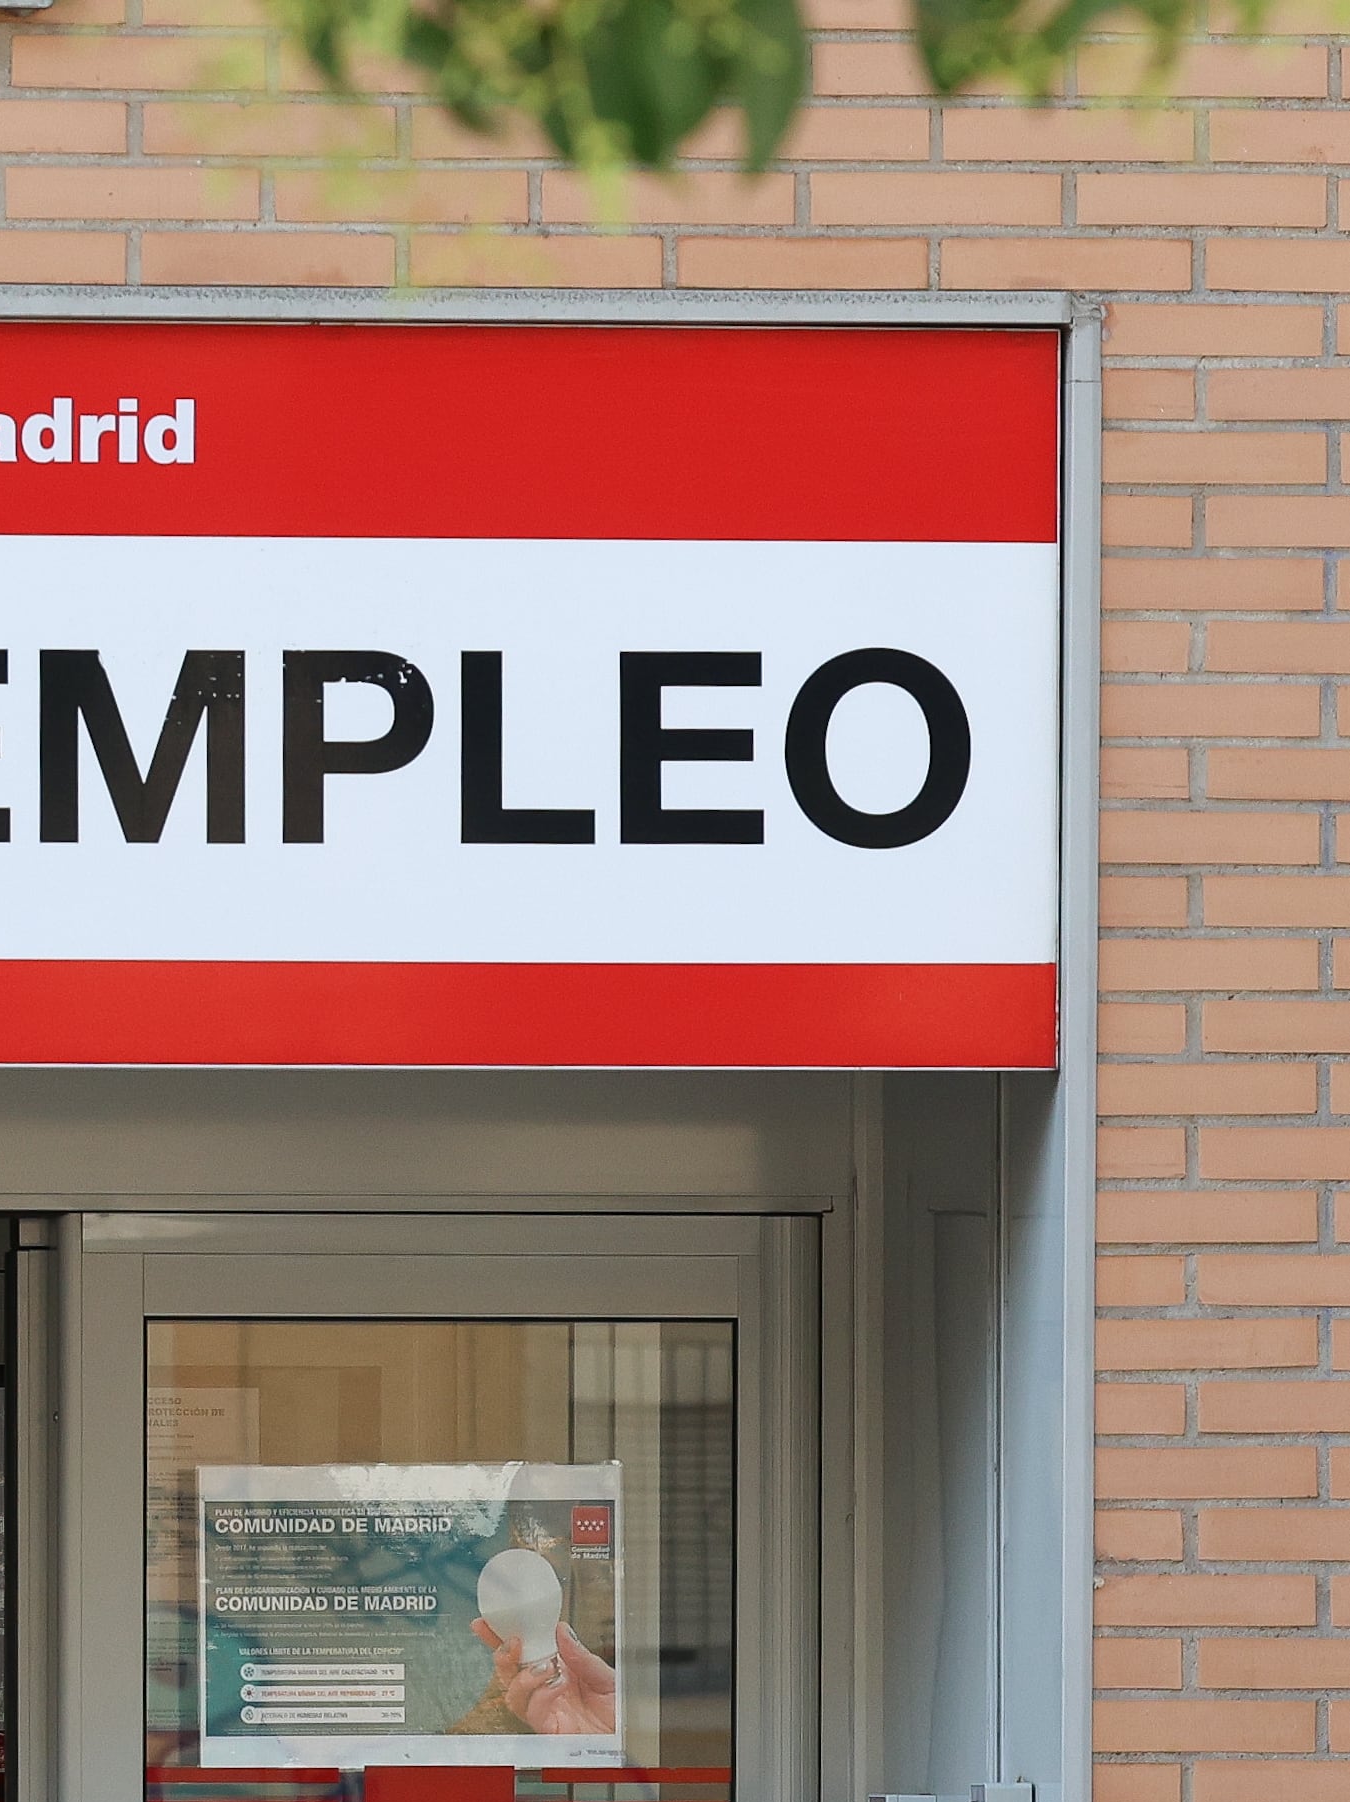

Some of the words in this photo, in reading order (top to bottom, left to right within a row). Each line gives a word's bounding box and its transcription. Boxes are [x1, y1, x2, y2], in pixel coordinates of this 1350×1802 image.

[215, 1518, 335, 1533] COMUNIDAD
[342, 1518, 368, 1532] DE
[375, 1518, 452, 1533] MADRID
[216, 1596, 328, 1612] COMUNIDAD
[334, 1597, 358, 1611] DE
[365, 1596, 437, 1611] MADRID
